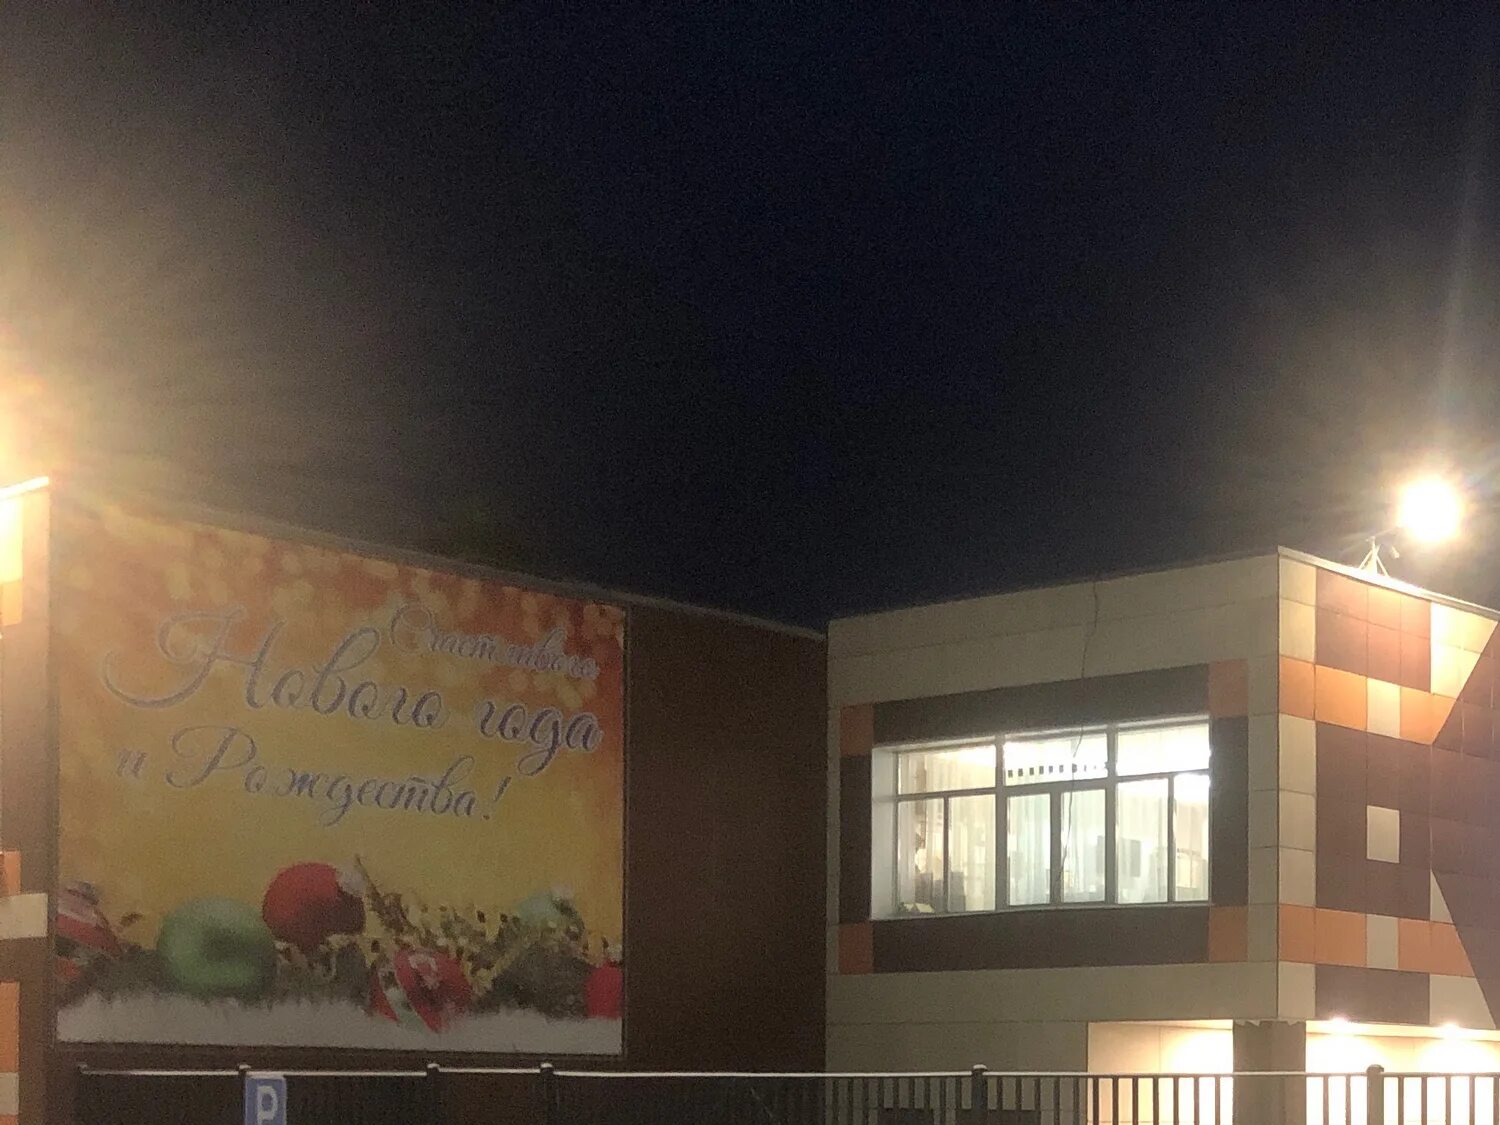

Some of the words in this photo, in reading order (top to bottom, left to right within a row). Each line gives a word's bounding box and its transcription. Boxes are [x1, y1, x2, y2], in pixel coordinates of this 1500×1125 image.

[103, 607, 449, 730] Нового
[478, 701, 601, 776] года
[165, 724, 513, 827] Рождества!
